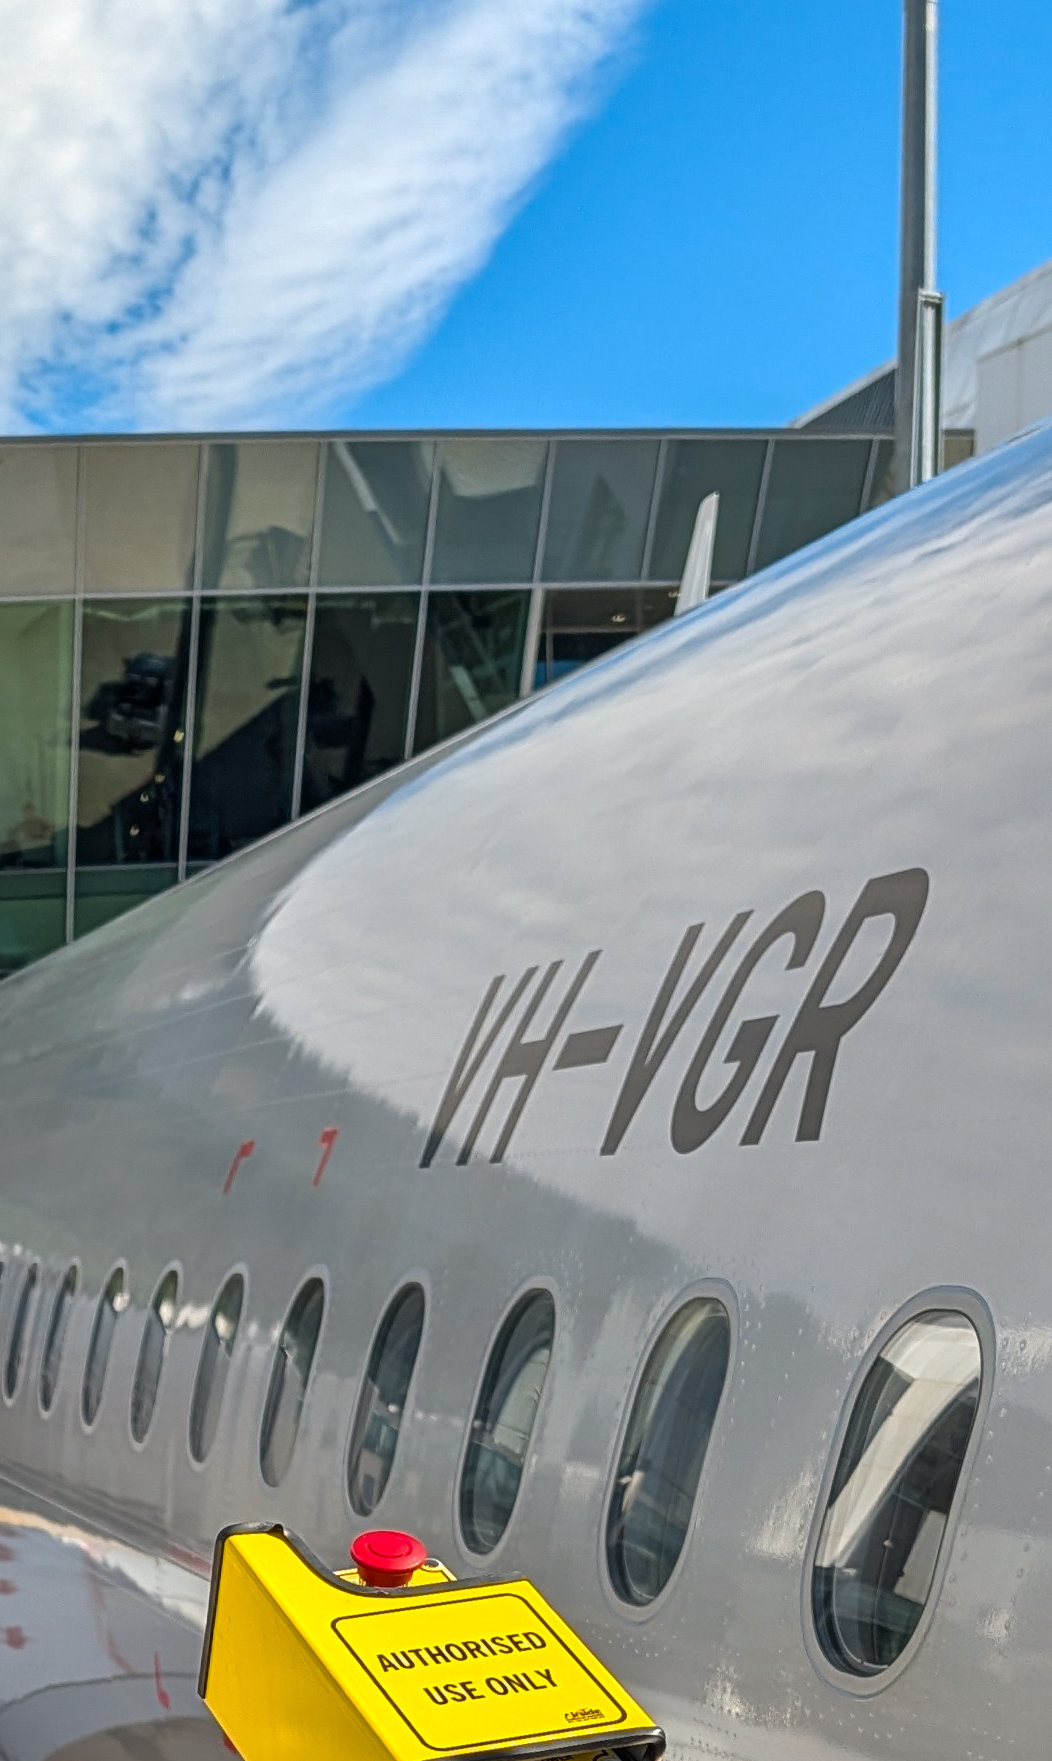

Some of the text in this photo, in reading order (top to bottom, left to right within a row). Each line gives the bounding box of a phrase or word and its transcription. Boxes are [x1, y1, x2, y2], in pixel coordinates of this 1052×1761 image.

[418, 867, 930, 1170] VH-VGR
[377, 1631, 547, 1673] AUTHORISED
[423, 1668, 558, 1705] USE ONLY
